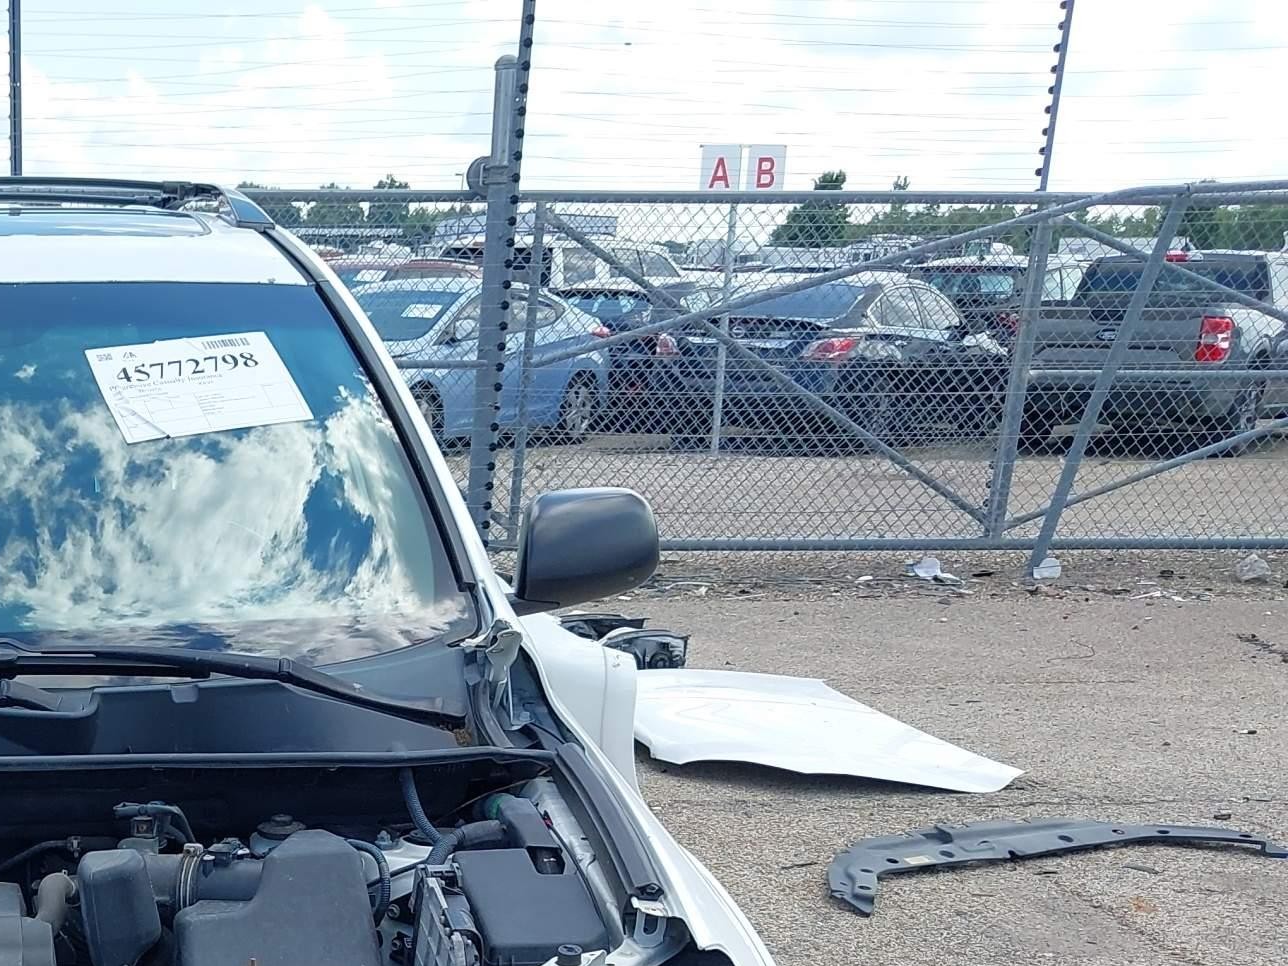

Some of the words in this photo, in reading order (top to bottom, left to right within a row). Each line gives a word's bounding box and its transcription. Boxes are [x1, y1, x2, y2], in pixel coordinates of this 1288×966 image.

[709, 157, 730, 188] A
[756, 157, 775, 188] B
[116, 351, 259, 383] 45772798
